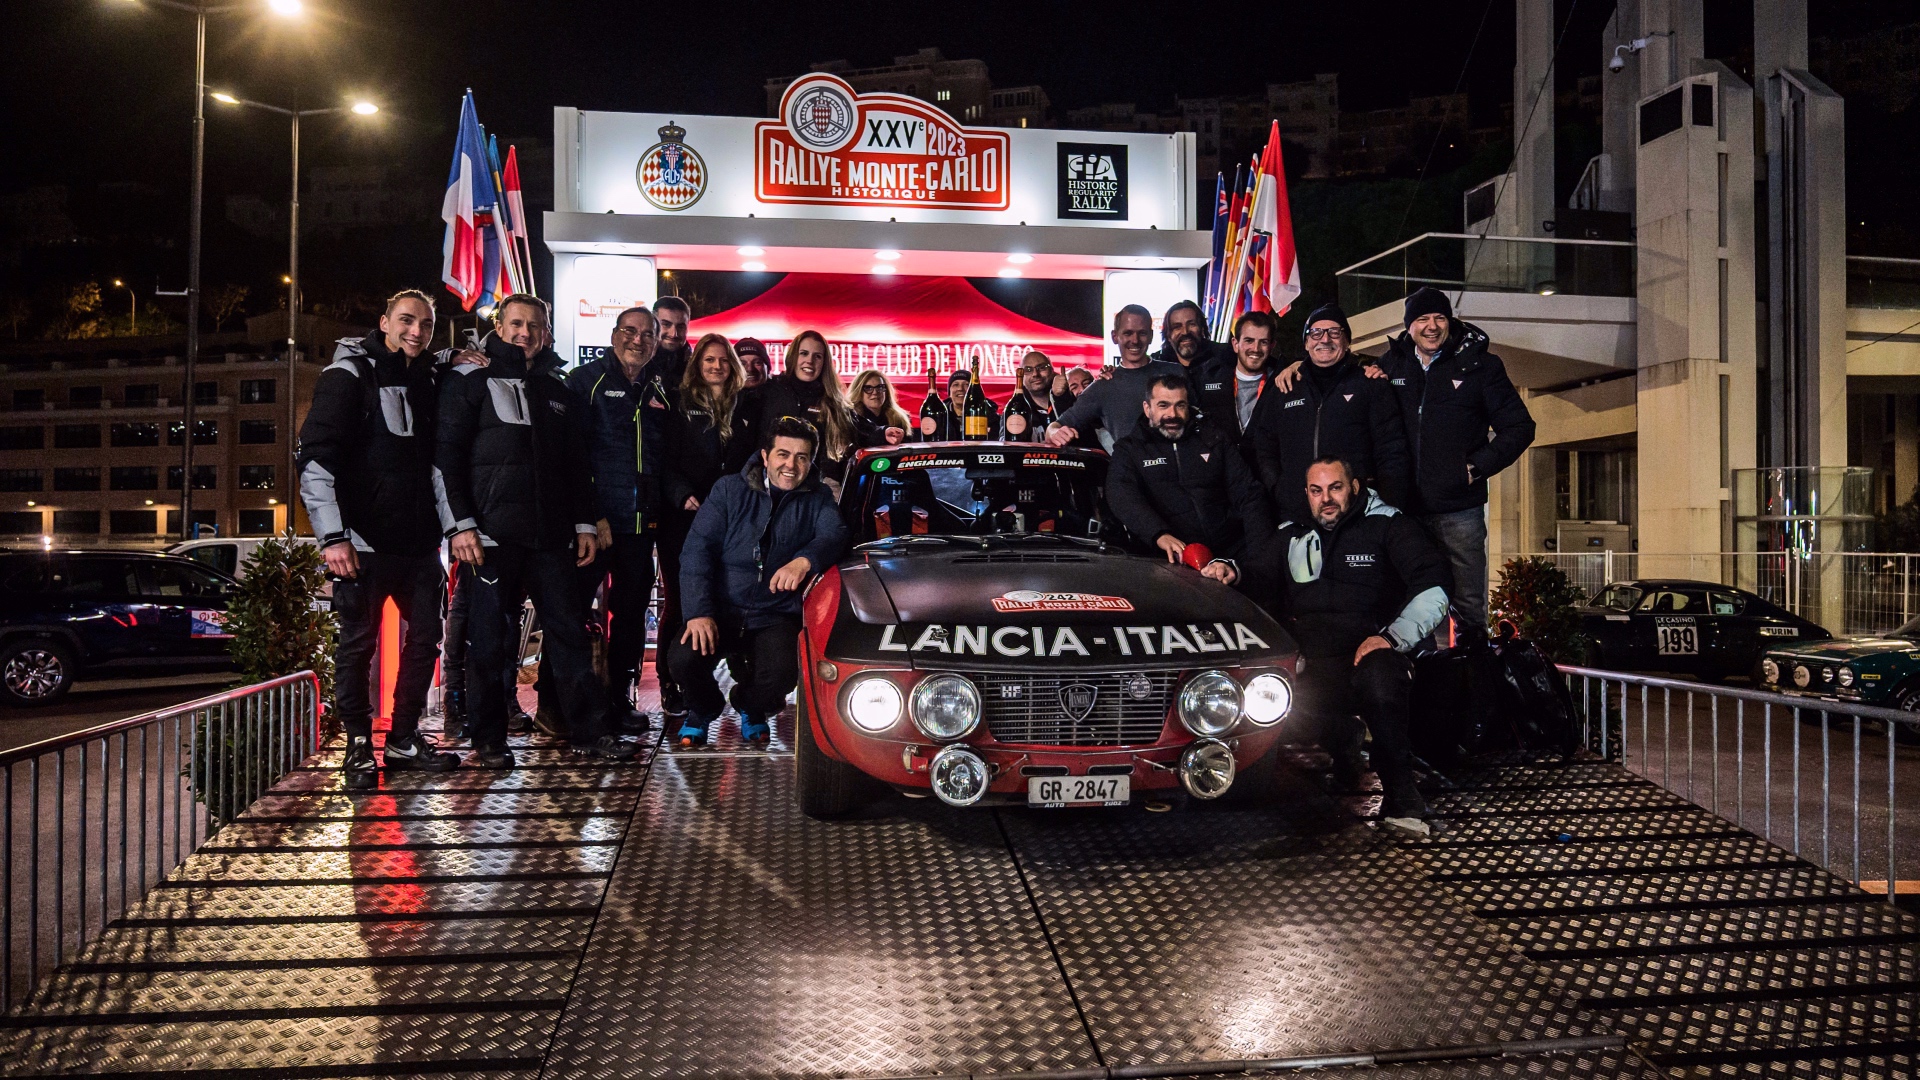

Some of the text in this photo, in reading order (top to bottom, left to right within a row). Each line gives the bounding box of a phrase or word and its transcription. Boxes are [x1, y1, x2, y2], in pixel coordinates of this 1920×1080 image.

[928, 122, 966, 157] 2023
[769, 138, 997, 193] RALLYE MONTE-CARLO
[1068, 181, 1117, 191] HISTORIC
[832, 187, 936, 200] HISTORIQUE
[1068, 189, 1117, 197] REGULARITY
[1072, 196, 1113, 209] RALLY
[581, 348, 593, 357] LE
[873, 344, 922, 377] CLUB
[925, 344, 951, 377] DE
[901, 454, 937, 462] AUTO
[1022, 458, 1085, 467] ENGIADINA
[897, 459, 965, 469] ENGIADINA
[1345, 554, 1375, 562] KESSEL
[1000, 600, 1127, 609] RALLYE MONTE-CARLO
[878, 624, 1090, 657] LANCIA
[1113, 622, 1271, 655] ITALIA
[1661, 628, 1695, 653] 199
[1002, 686, 1021, 697] HF
